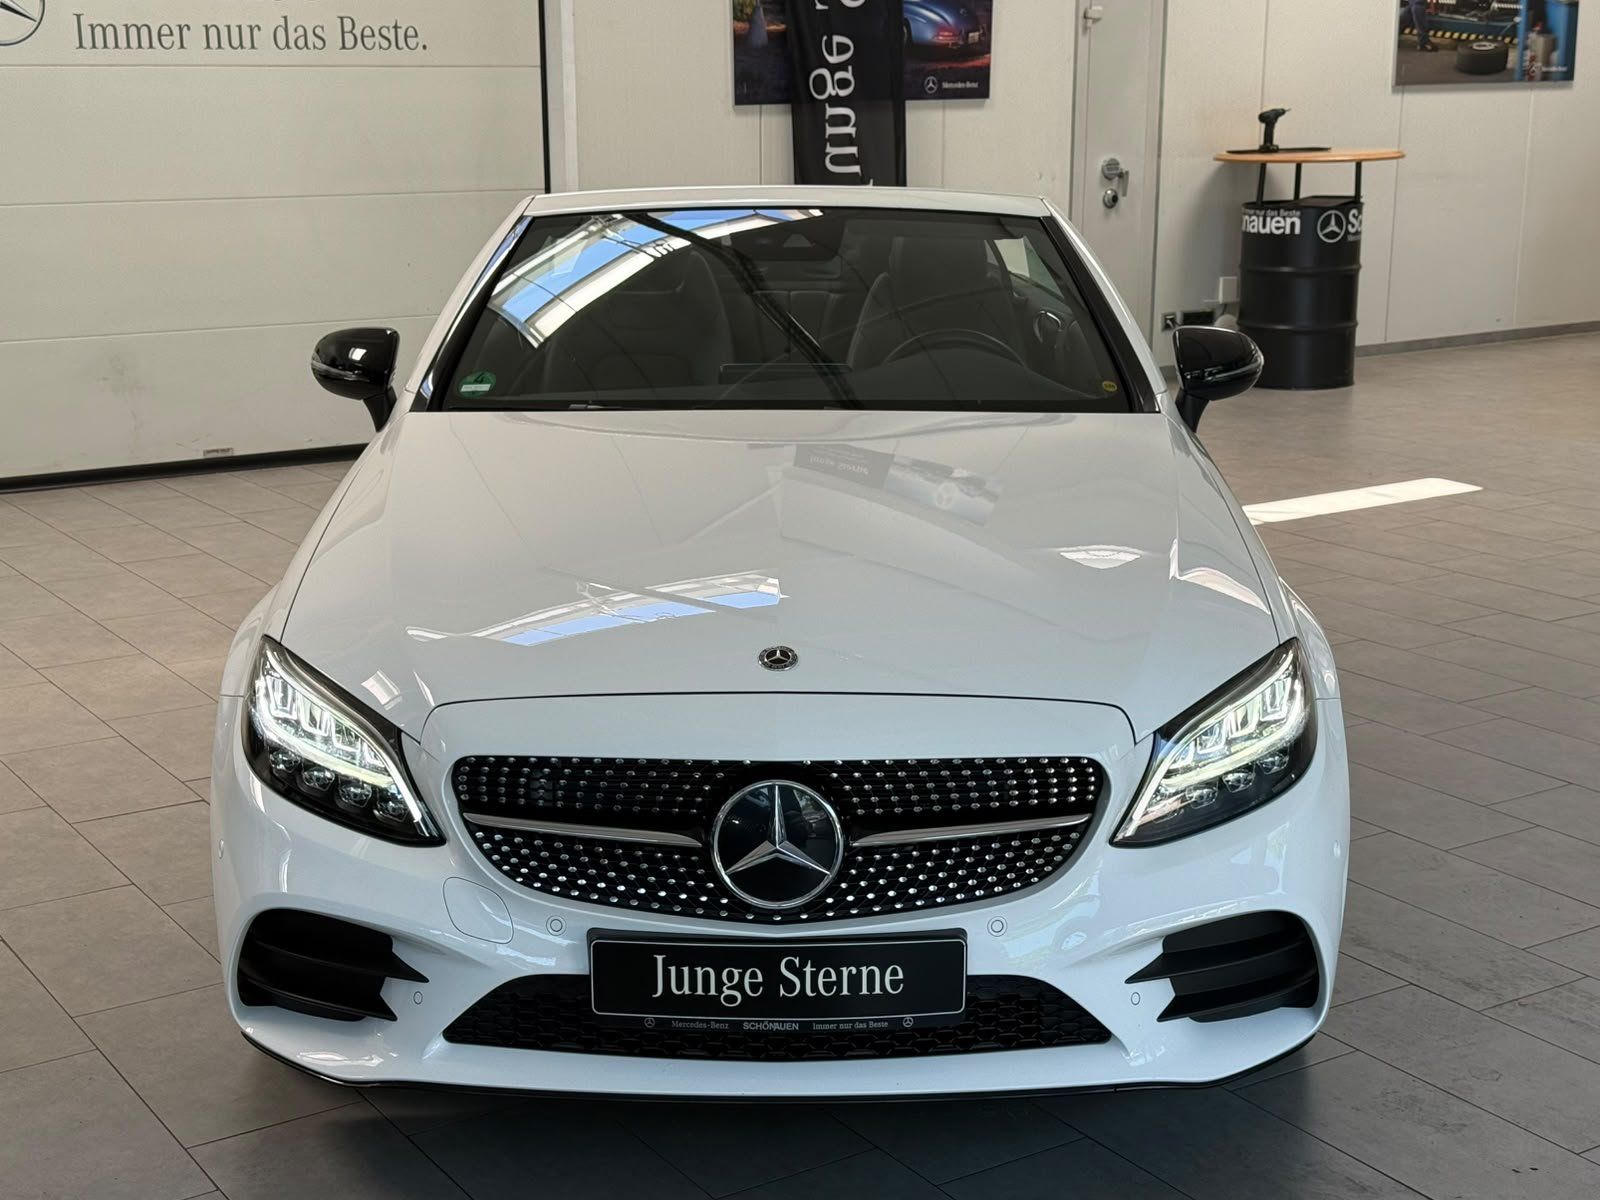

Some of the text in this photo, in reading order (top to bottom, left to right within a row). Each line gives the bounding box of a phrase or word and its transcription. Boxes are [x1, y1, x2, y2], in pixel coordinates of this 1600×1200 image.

[72, 13, 428, 50] Immer nur das Beste.
[652, 955, 904, 1007] Junge Sterne
[671, 1020, 799, 1031] Mercedes-Benz SCHÖNAUEN
[813, 1022, 837, 1030] Immer
[854, 1021, 867, 1029] das
[869, 1020, 889, 1028] Beste
